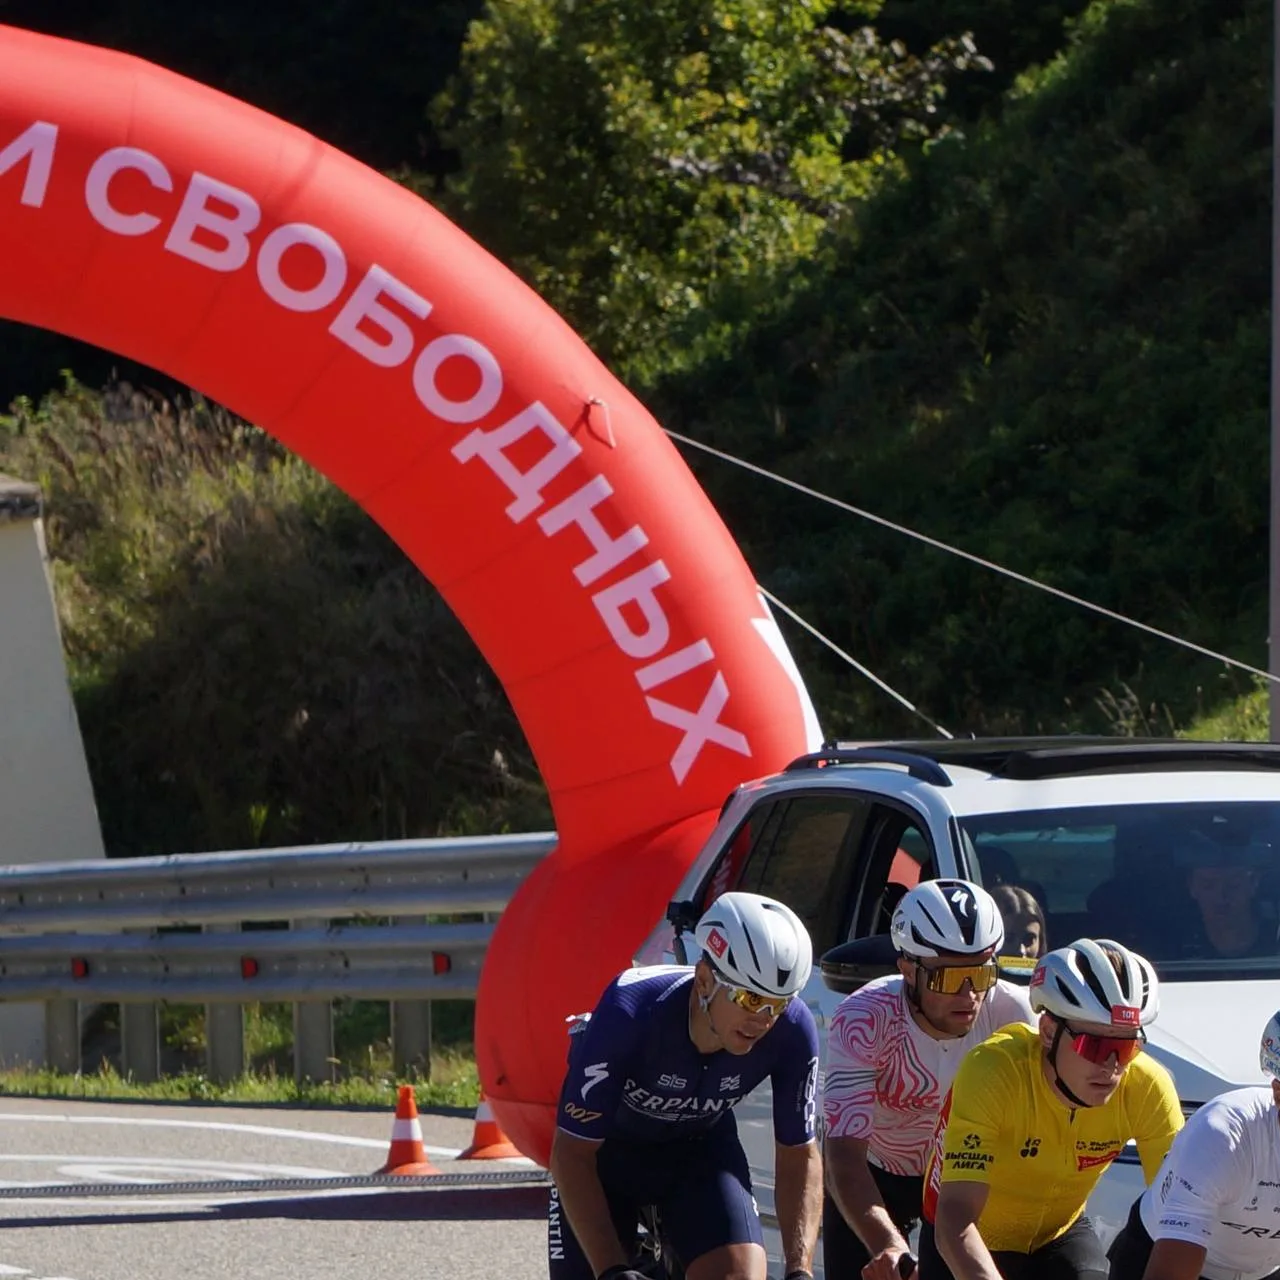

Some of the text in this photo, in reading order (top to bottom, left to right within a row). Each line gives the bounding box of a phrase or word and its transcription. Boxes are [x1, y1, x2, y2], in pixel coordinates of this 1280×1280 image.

[84, 146, 752, 786] СВОБОДНЫХ
[1121, 1009, 1135, 1019] 101
[623, 1078, 747, 1112] SERPANT
[564, 1102, 602, 1123] 007
[952, 1161, 986, 1171] ЛИГА
[549, 1187, 565, 1260] PANTIN
